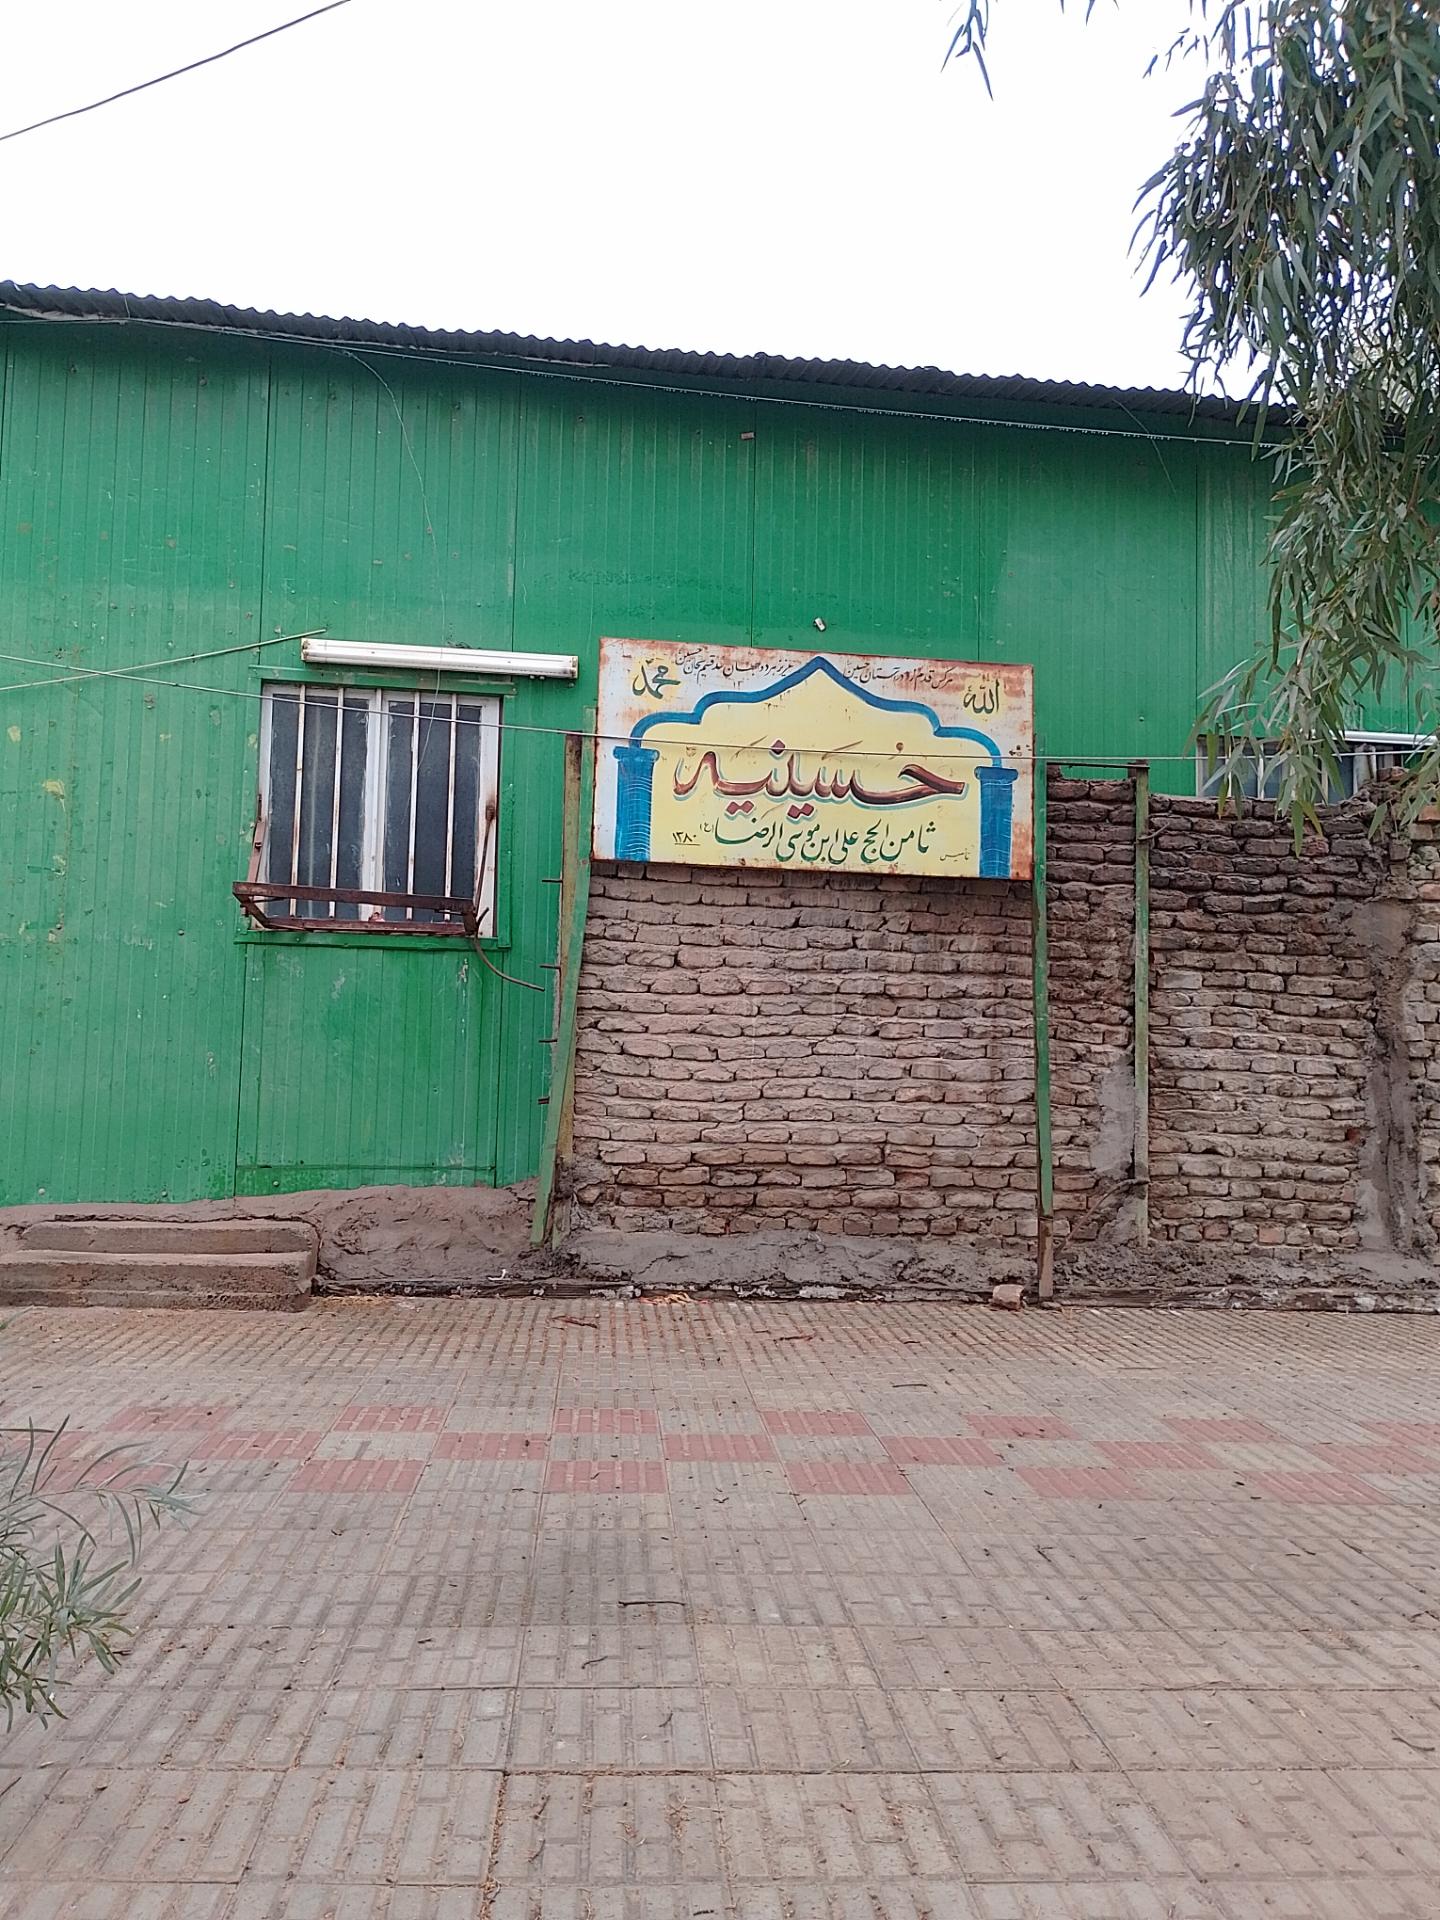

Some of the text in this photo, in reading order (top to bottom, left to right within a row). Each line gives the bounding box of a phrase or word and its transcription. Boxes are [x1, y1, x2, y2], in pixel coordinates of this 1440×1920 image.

[672, 739, 966, 820] حسینیه
[714, 816, 784, 848] الرضا
[775, 823, 821, 862] موسی
[827, 829, 859, 865] علی
[879, 821, 937, 862] ثامن
